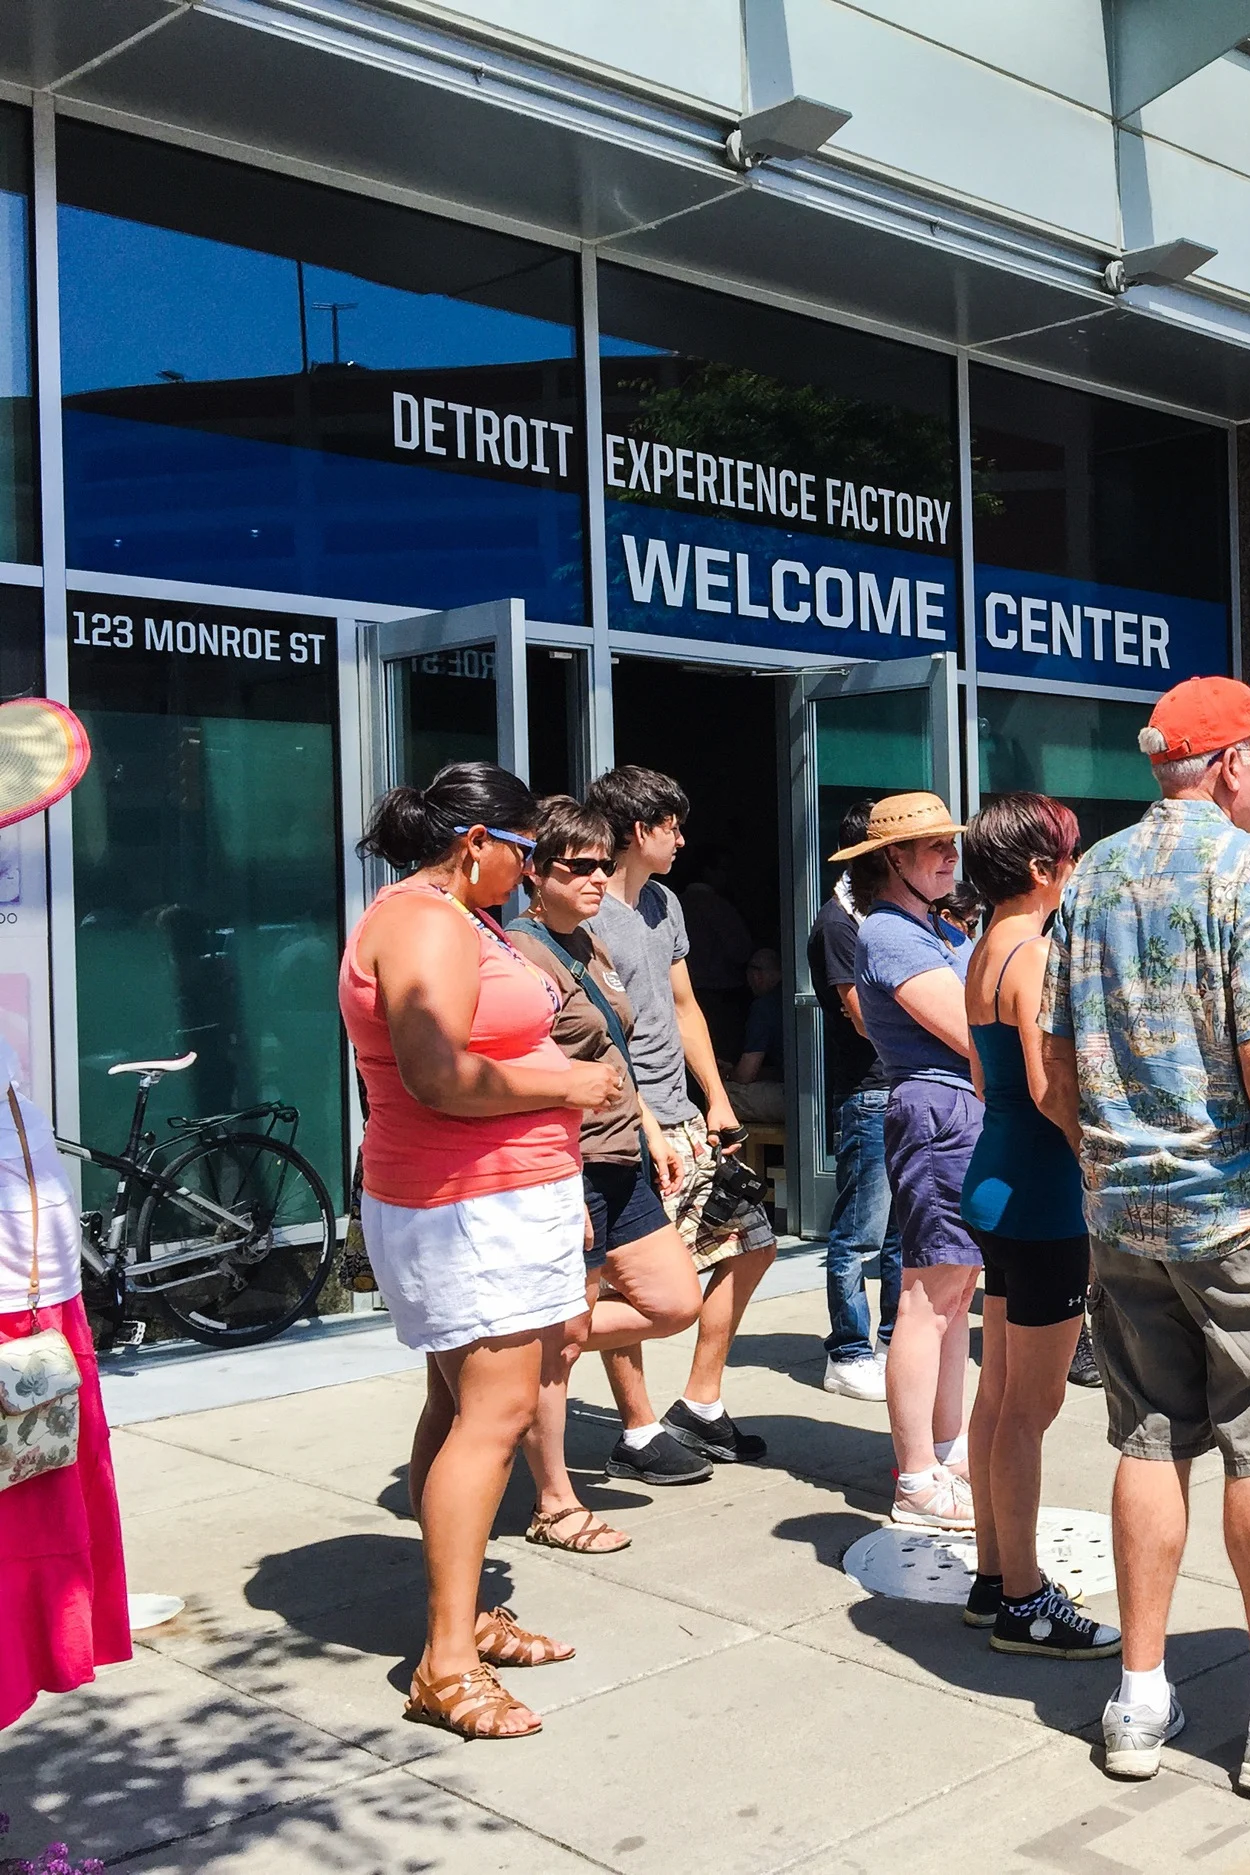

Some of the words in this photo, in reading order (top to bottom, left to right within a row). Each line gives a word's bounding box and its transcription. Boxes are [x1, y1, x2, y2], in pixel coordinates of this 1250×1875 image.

[392, 391, 574, 478] DETROIT
[605, 434, 818, 522] EXPERIENCE
[826, 478, 952, 546] FACTORY
[72, 610, 134, 648] 123
[144, 617, 280, 663] MONROE
[288, 631, 326, 666] ST
[622, 534, 946, 641] WELCOME
[984, 591, 1171, 670] CENTER
